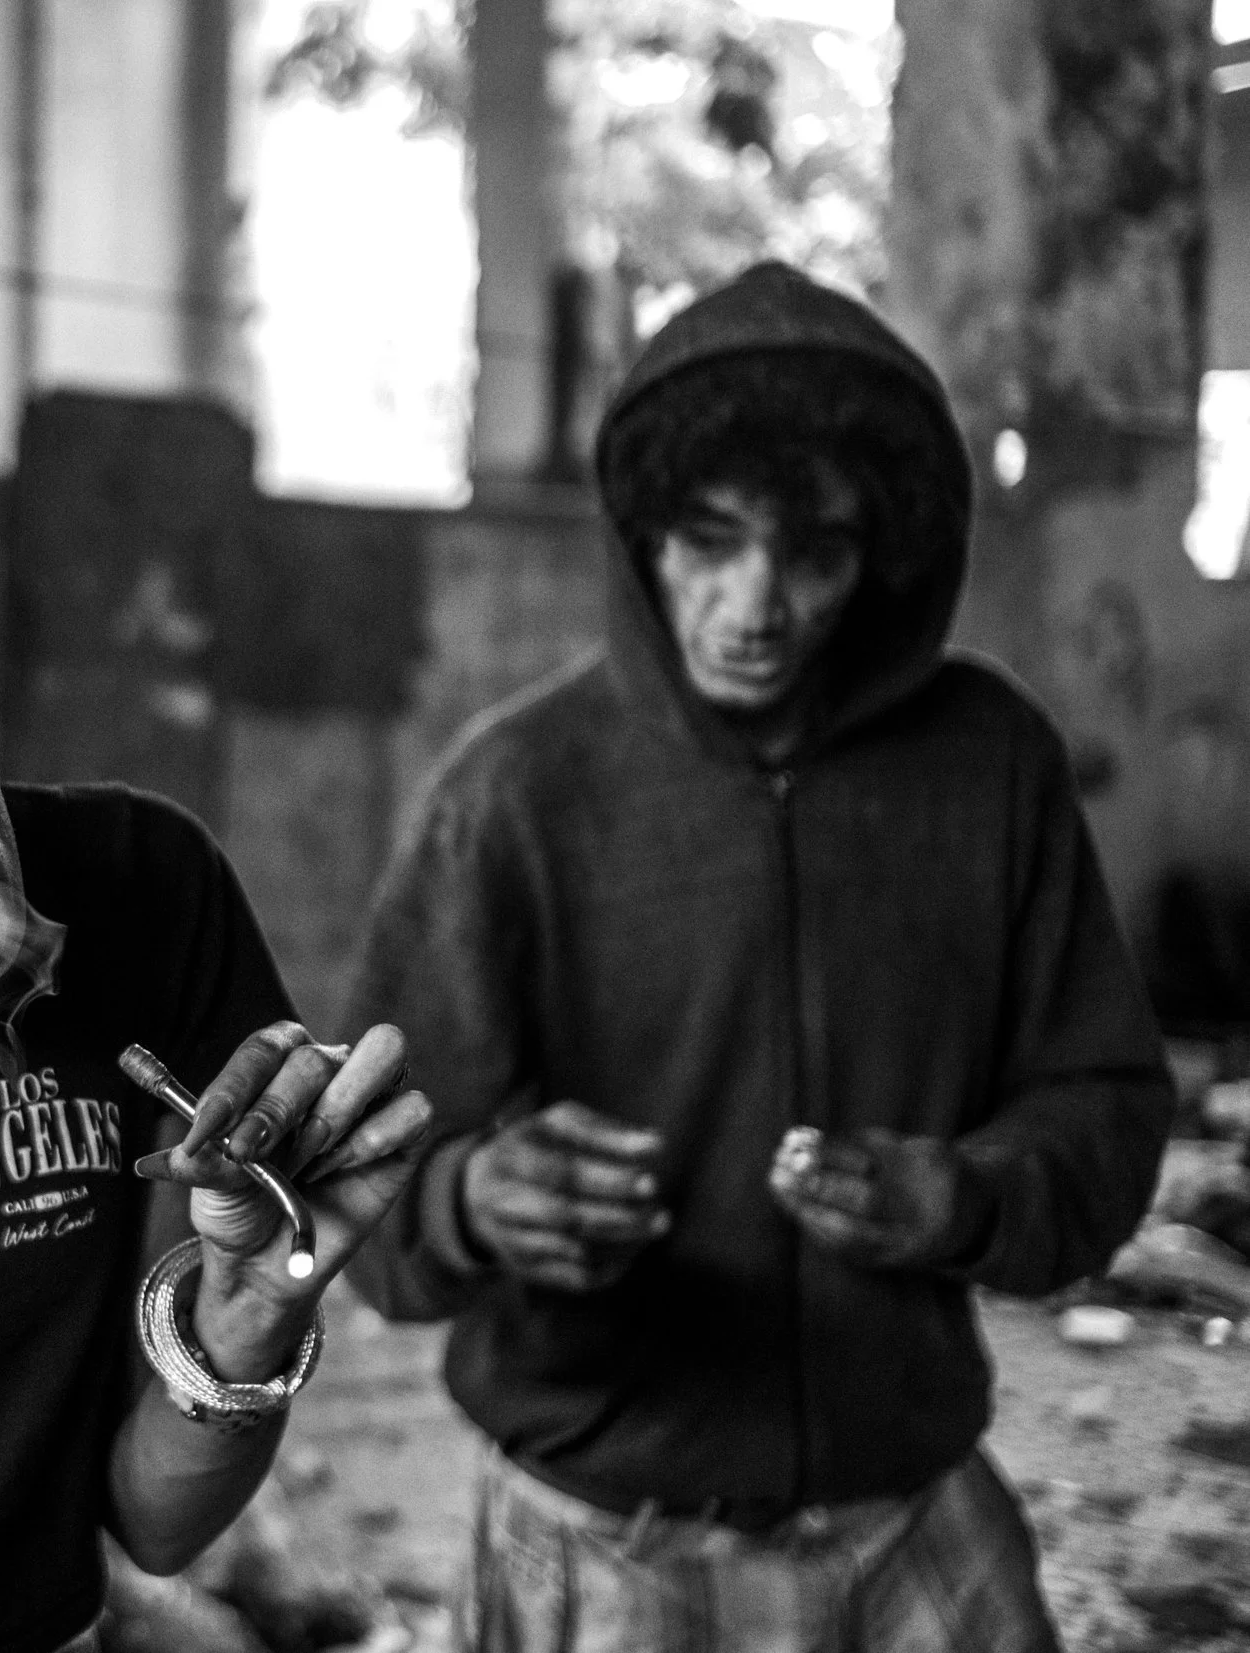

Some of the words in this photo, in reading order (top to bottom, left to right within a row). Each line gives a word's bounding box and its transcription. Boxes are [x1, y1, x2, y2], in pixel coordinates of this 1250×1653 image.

[3, 1199, 35, 1215] CALI
[3, 1221, 49, 1248] West
[53, 1208, 95, 1238] Coast
